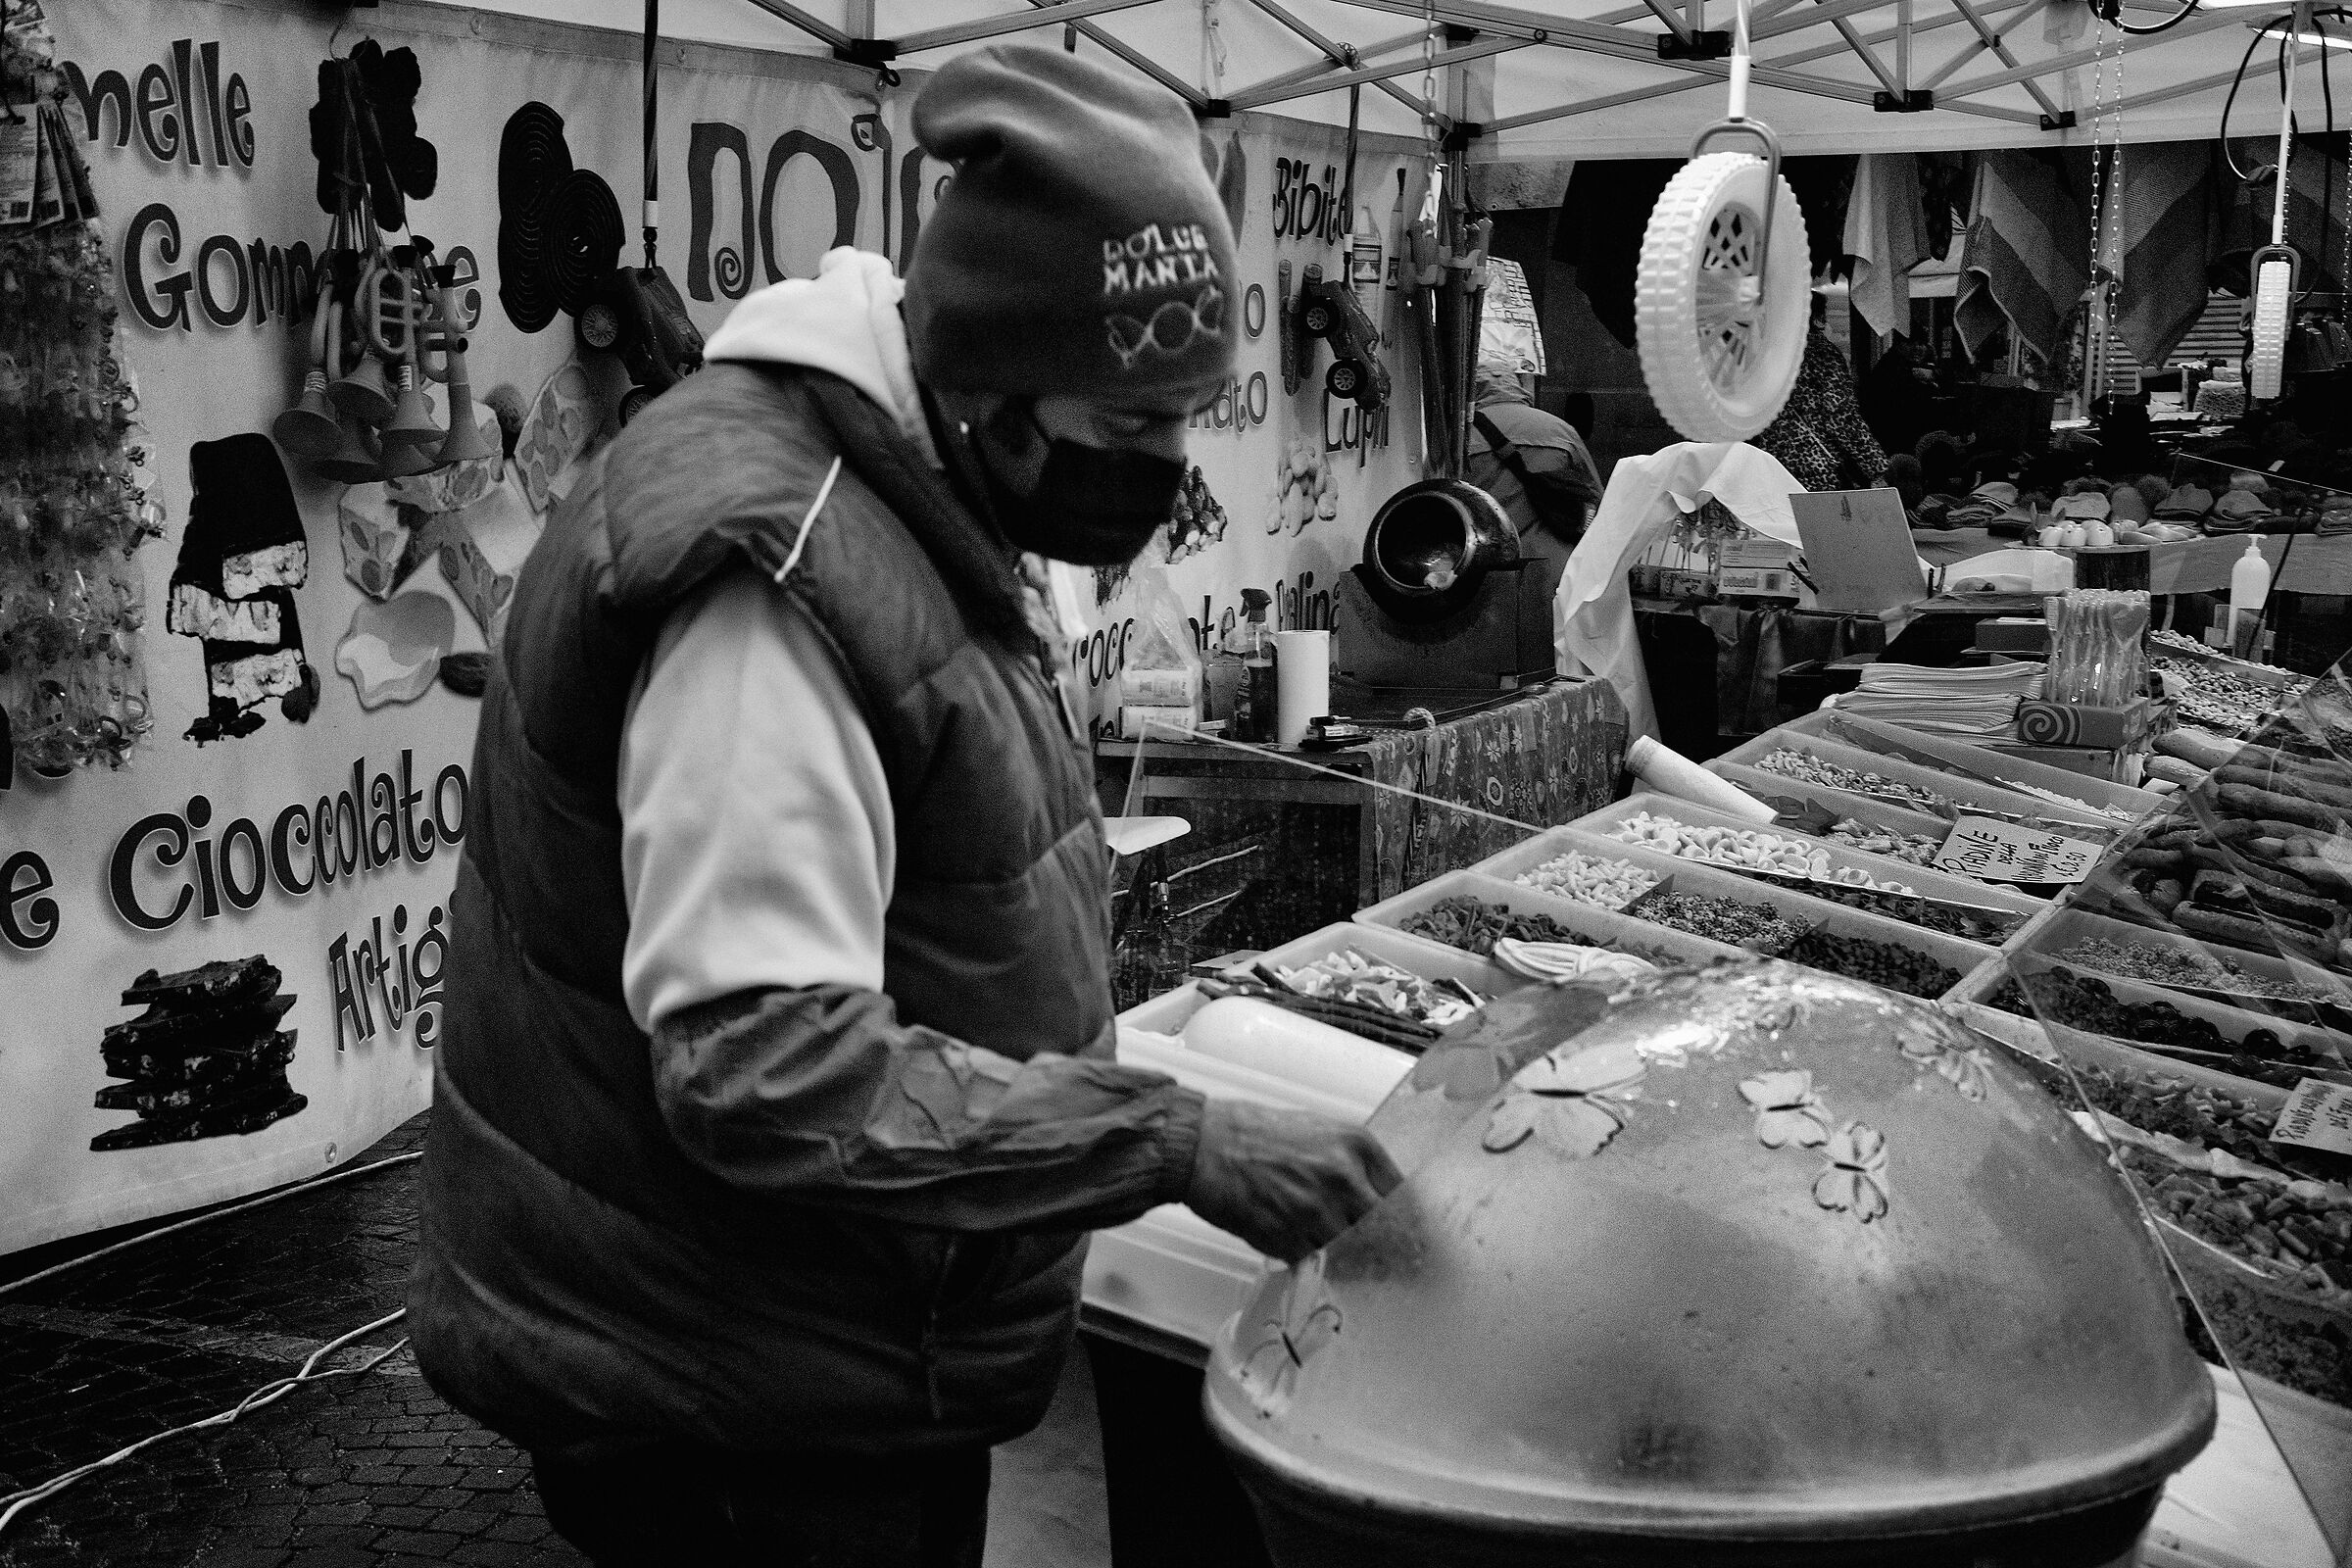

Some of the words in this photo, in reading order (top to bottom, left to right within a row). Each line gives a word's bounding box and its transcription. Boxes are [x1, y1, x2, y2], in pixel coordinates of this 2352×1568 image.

[1103, 251, 1218, 294] MANIA
[110, 748, 468, 931] Cioccolato
[328, 905, 452, 1052] Artig
